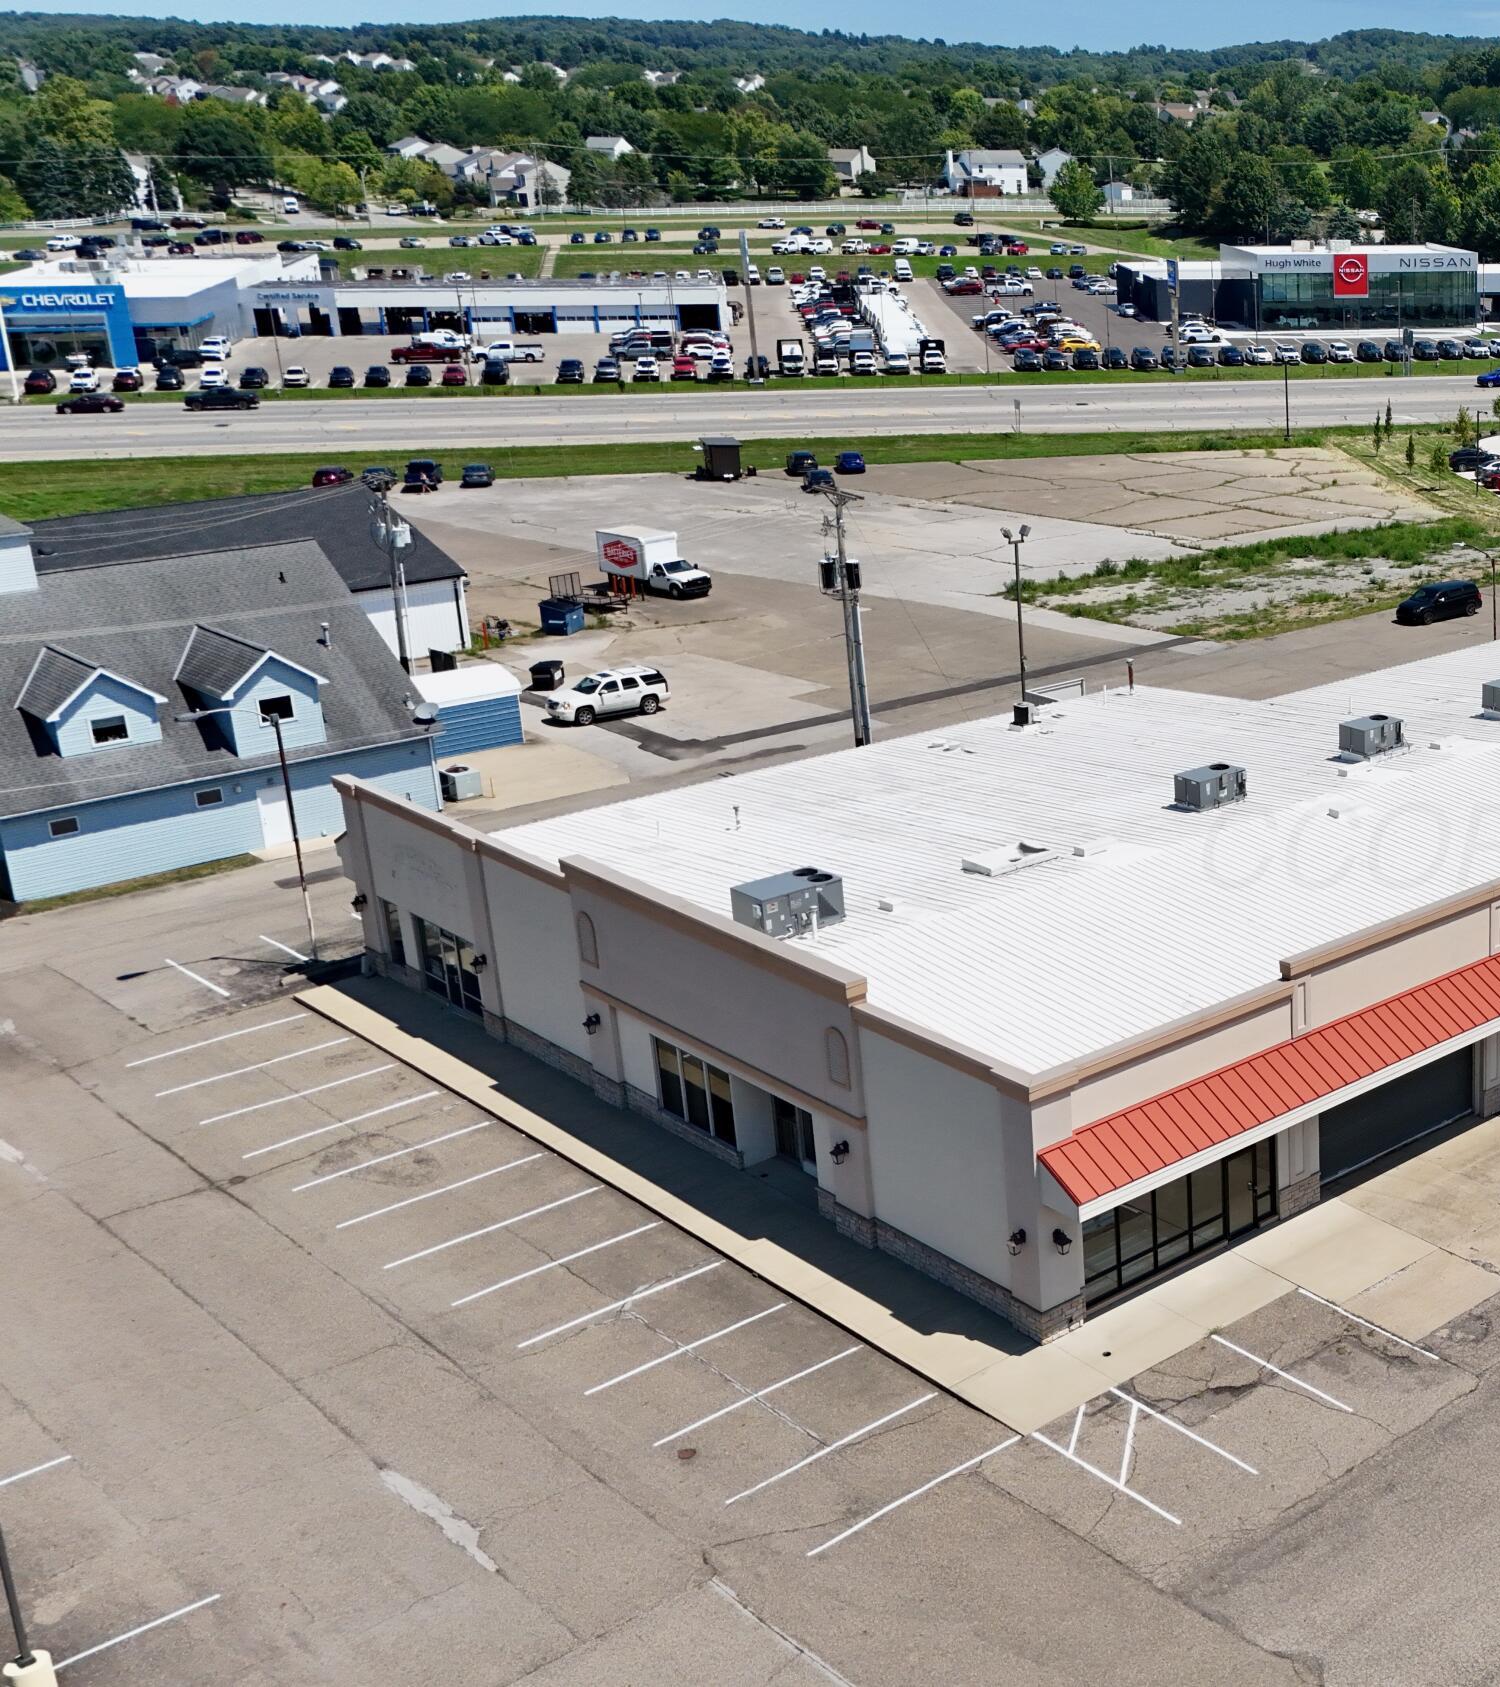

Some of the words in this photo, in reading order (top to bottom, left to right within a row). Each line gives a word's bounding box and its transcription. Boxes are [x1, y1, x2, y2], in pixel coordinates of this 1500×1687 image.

[1265, 259, 1291, 269] Hugh
[1294, 259, 1321, 267] White
[1400, 257, 1471, 268] NISSAN
[21, 293, 115, 306] CHEVROLET
